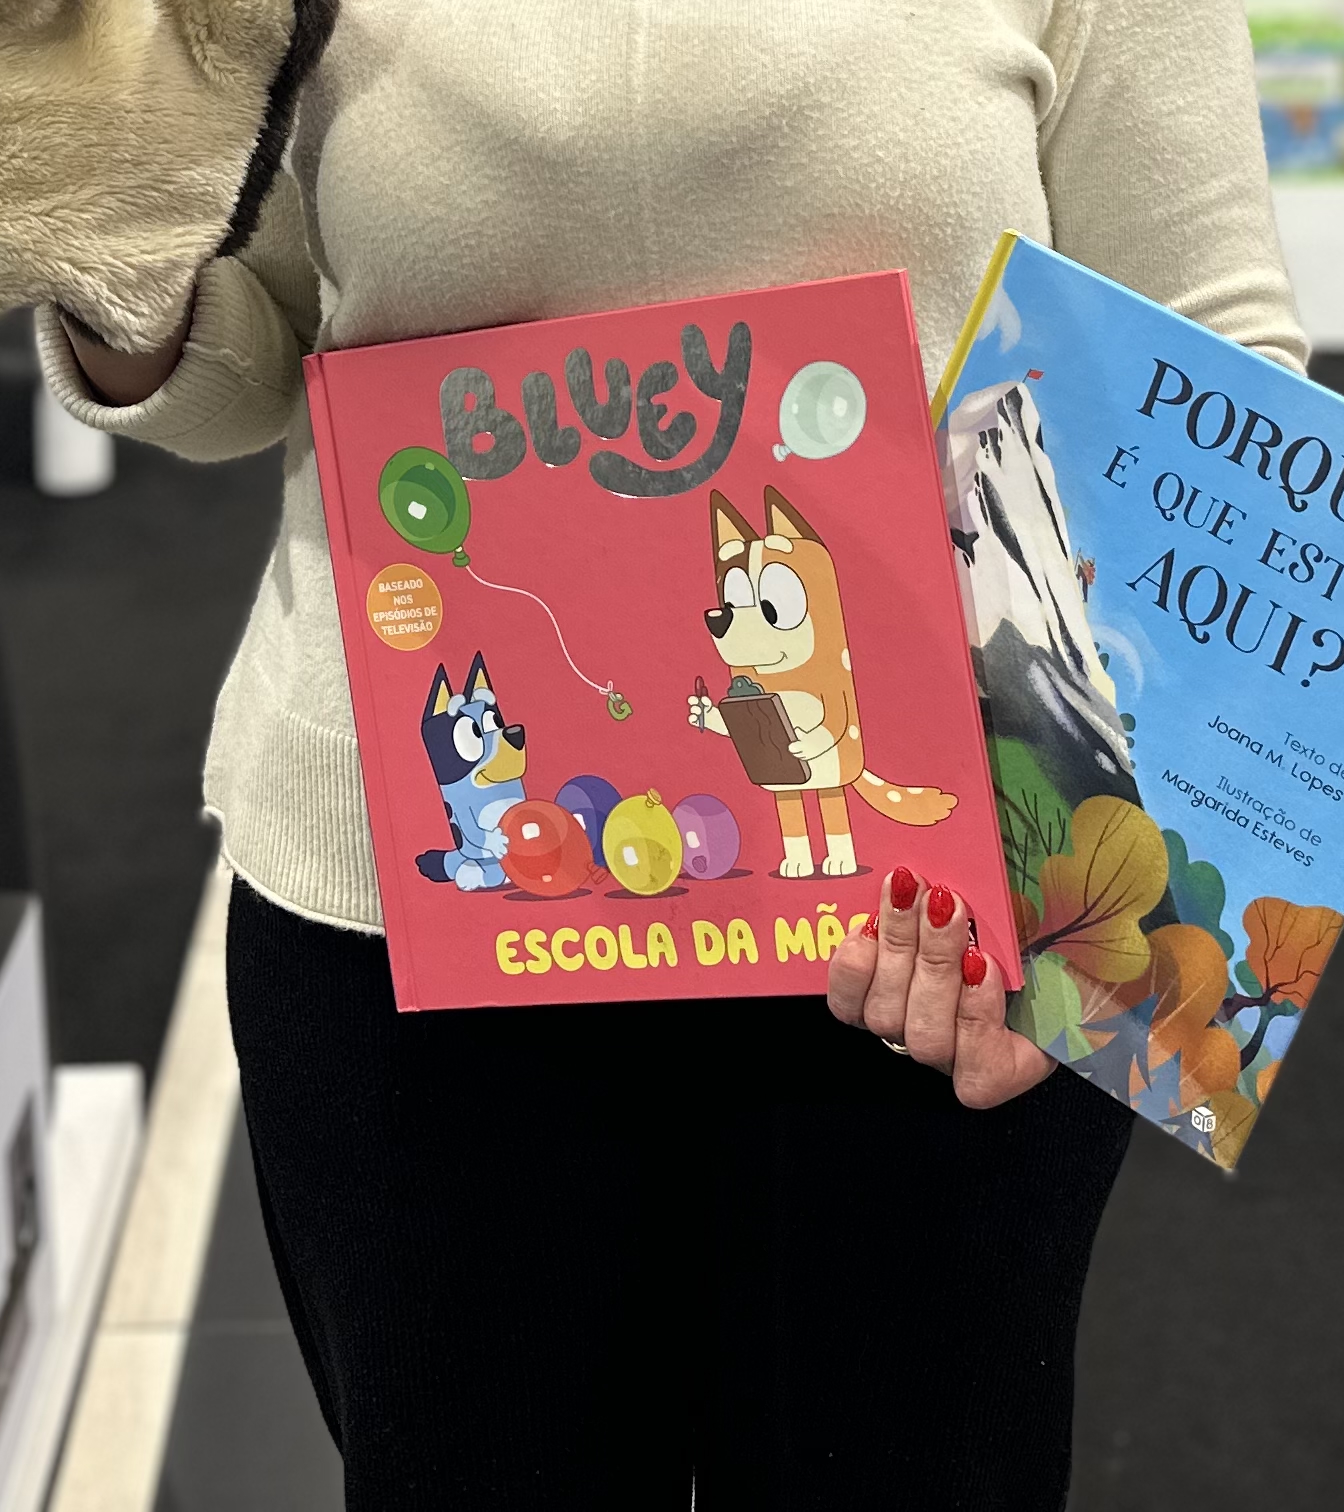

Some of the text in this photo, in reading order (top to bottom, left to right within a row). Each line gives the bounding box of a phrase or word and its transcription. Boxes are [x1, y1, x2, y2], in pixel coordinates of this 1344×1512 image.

[438, 321, 752, 499] BLUEY
[1102, 445, 1139, 488] É
[1153, 472, 1247, 545] QUE
[372, 606, 438, 622] EPISÓDIOS DE
[378, 578, 424, 593] BASEADO
[393, 594, 414, 606] NOS
[381, 620, 433, 635] TELEVISÃO
[1208, 715, 1344, 802] Joana M. Lopes
[1283, 732, 1325, 765] Texto
[1161, 769, 1315, 867] Margarida Esteves
[1216, 775, 1322, 846] Ilustração de
[495, 921, 679, 975] ESCOLA
[693, 918, 759, 967] DA
